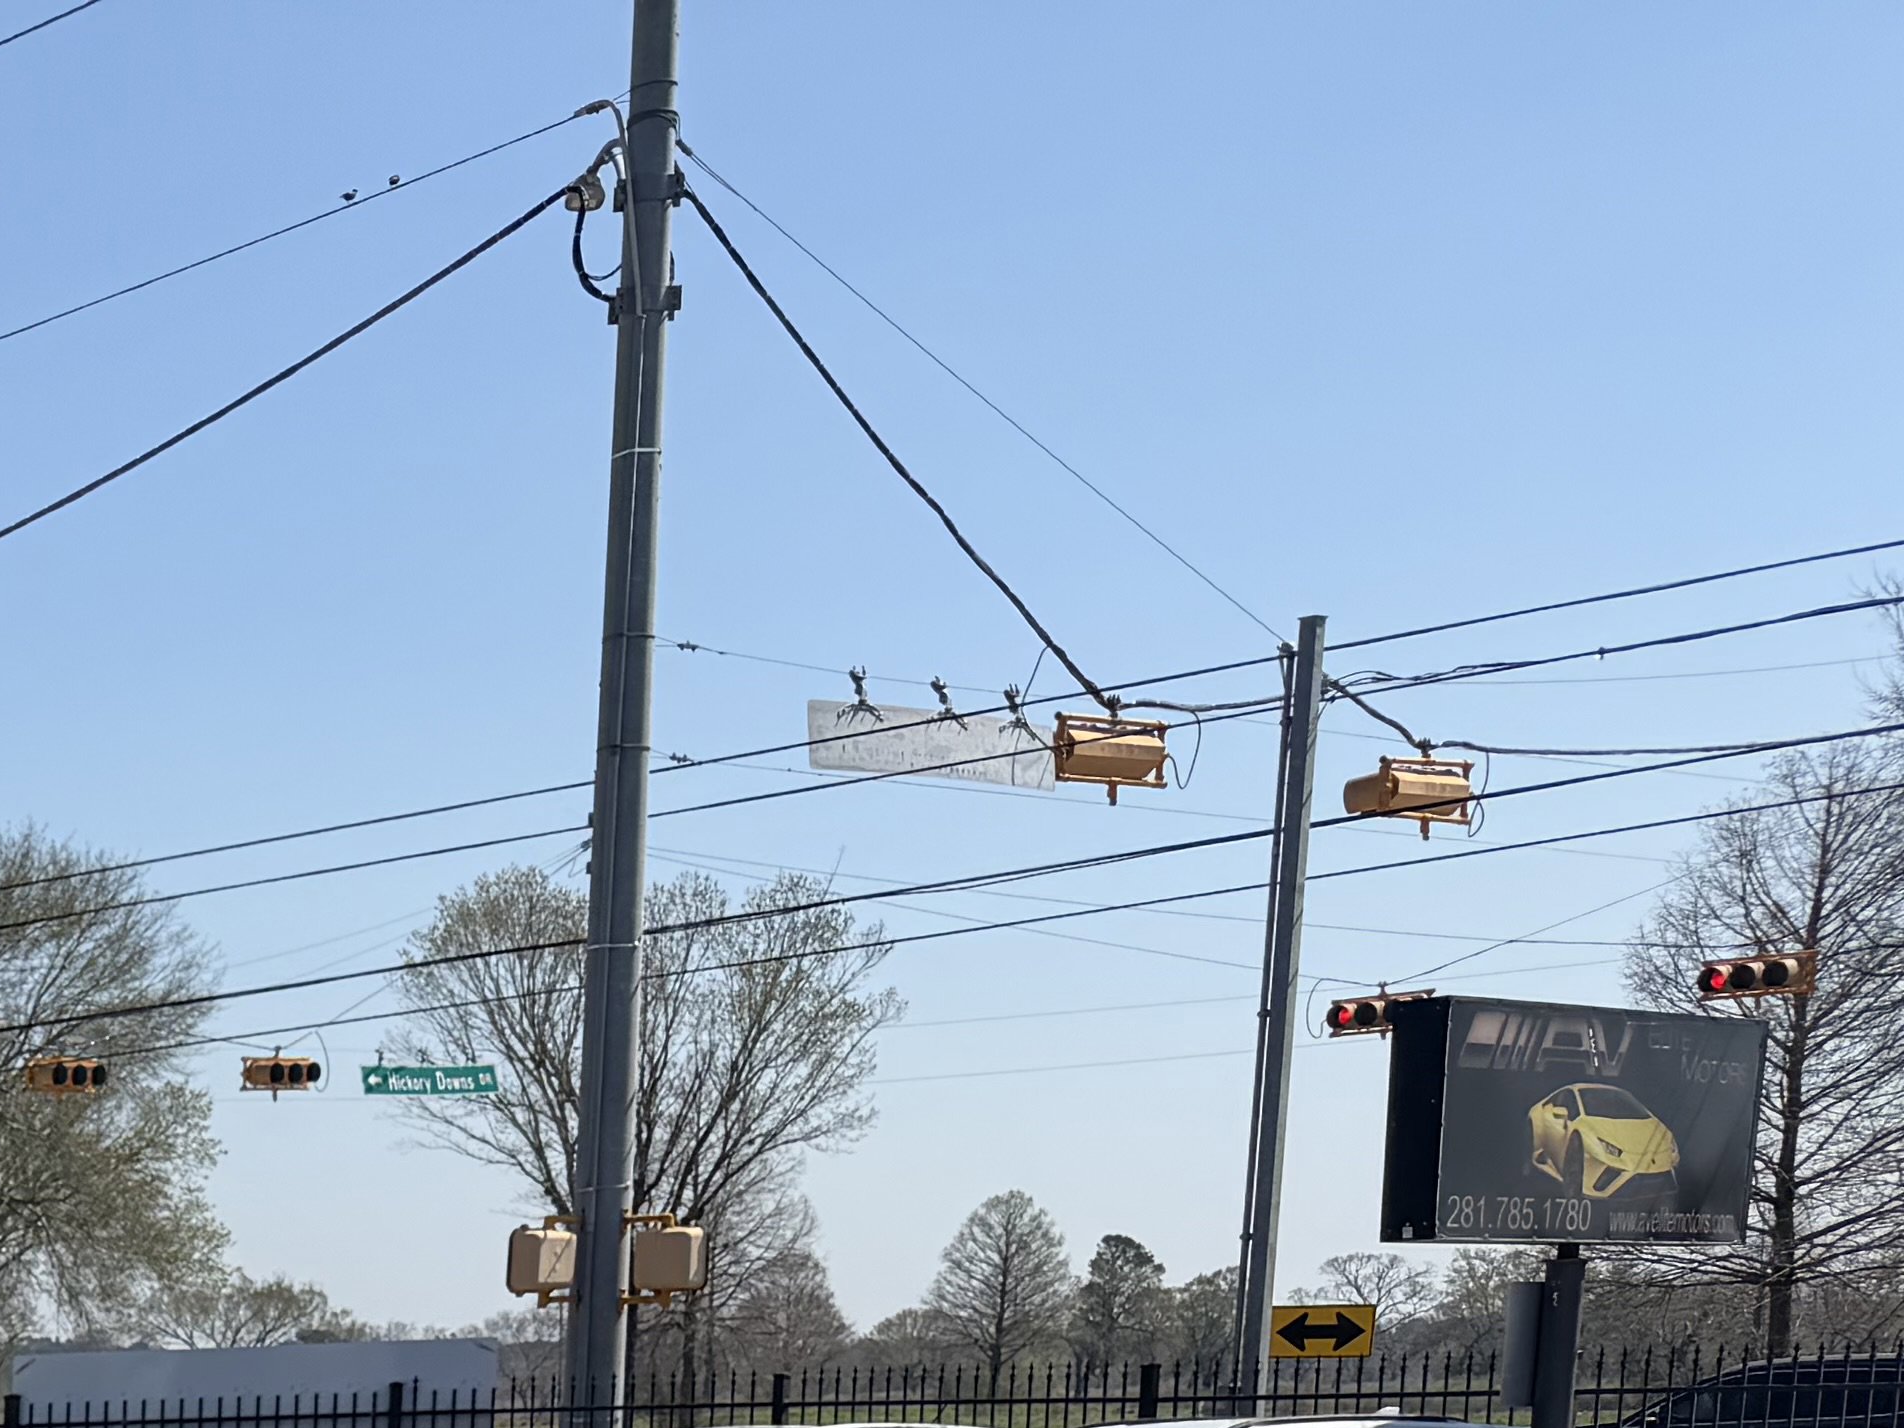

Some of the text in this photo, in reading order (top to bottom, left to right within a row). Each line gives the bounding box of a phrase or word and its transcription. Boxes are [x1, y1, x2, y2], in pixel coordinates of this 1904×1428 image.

[387, 1071, 431, 1094] Hickory
[435, 1070, 475, 1091] Downs
[1446, 1194, 1592, 1232] 281.785.1780
